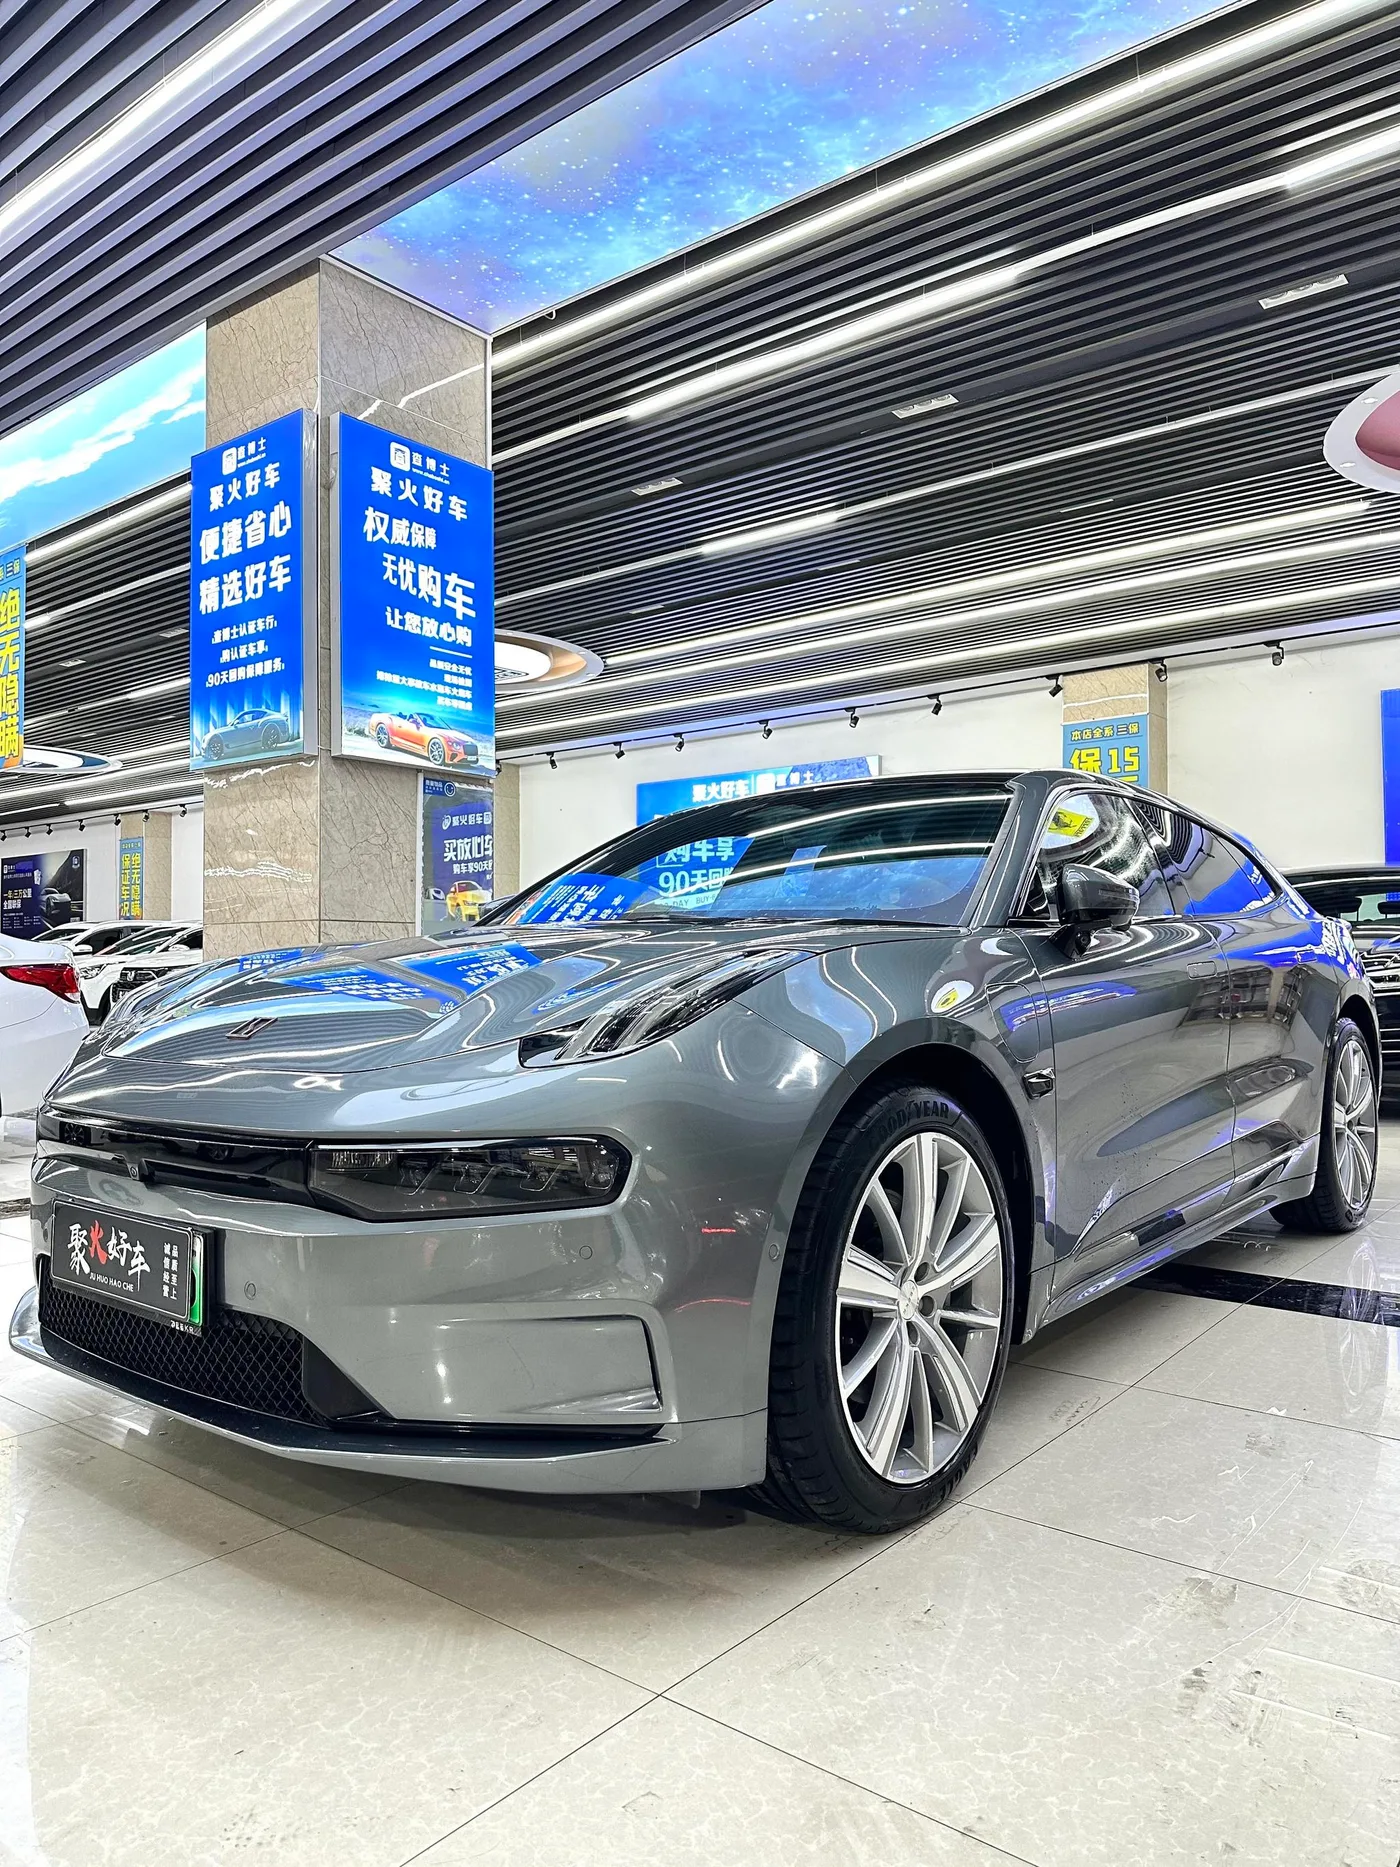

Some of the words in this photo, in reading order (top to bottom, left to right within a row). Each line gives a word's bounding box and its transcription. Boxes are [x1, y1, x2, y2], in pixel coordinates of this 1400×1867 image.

[209, 462, 280, 512] 聚火好车
[411, 451, 450, 477] 查博士
[370, 466, 468, 521] 聚火好车
[199, 500, 292, 565] 便捷省心
[363, 506, 437, 550] 权威保障
[199, 554, 291, 615] 精选好车
[382, 552, 476, 620] 无忧购车
[385, 606, 472, 647] 让您放心购
[1071, 725, 1114, 741] 本店全系
[1117, 722, 1139, 735] 三保
[1070, 746, 1101, 774] 保
[1108, 746, 1139, 774] 15
[692, 779, 750, 802] 聚火好车
[67, 1219, 151, 1292] 聚火好车
[163, 1242, 171, 1298] 诚信经营
[170, 1244, 179, 1300] 品质至上
[90, 1272, 96, 1281] JU
[97, 1274, 109, 1285] HUO
[109, 1277, 122, 1289] HAO
[122, 1282, 134, 1292] CHE
